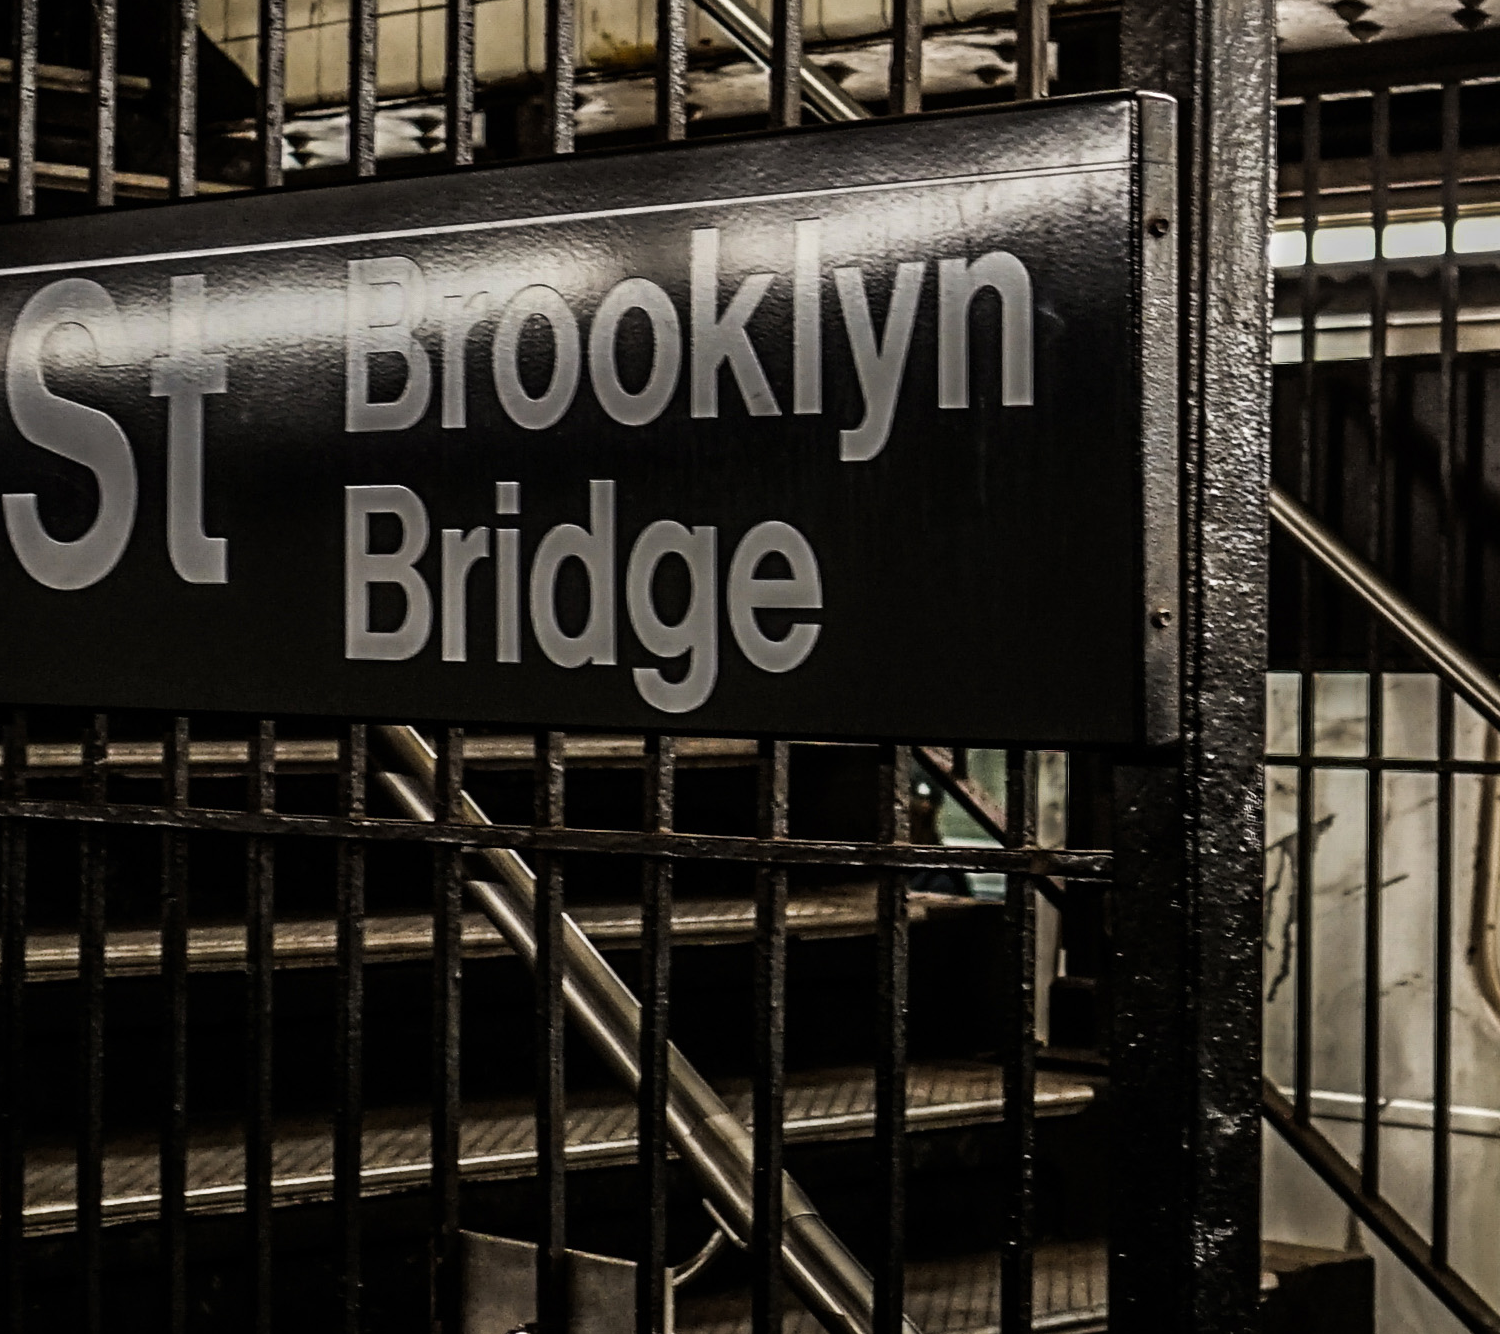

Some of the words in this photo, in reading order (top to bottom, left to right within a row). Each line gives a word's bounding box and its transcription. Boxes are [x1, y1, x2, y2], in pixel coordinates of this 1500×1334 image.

[2, 273, 230, 594] St
[342, 218, 1035, 462] Brooklyn
[342, 478, 825, 714] Bridge
